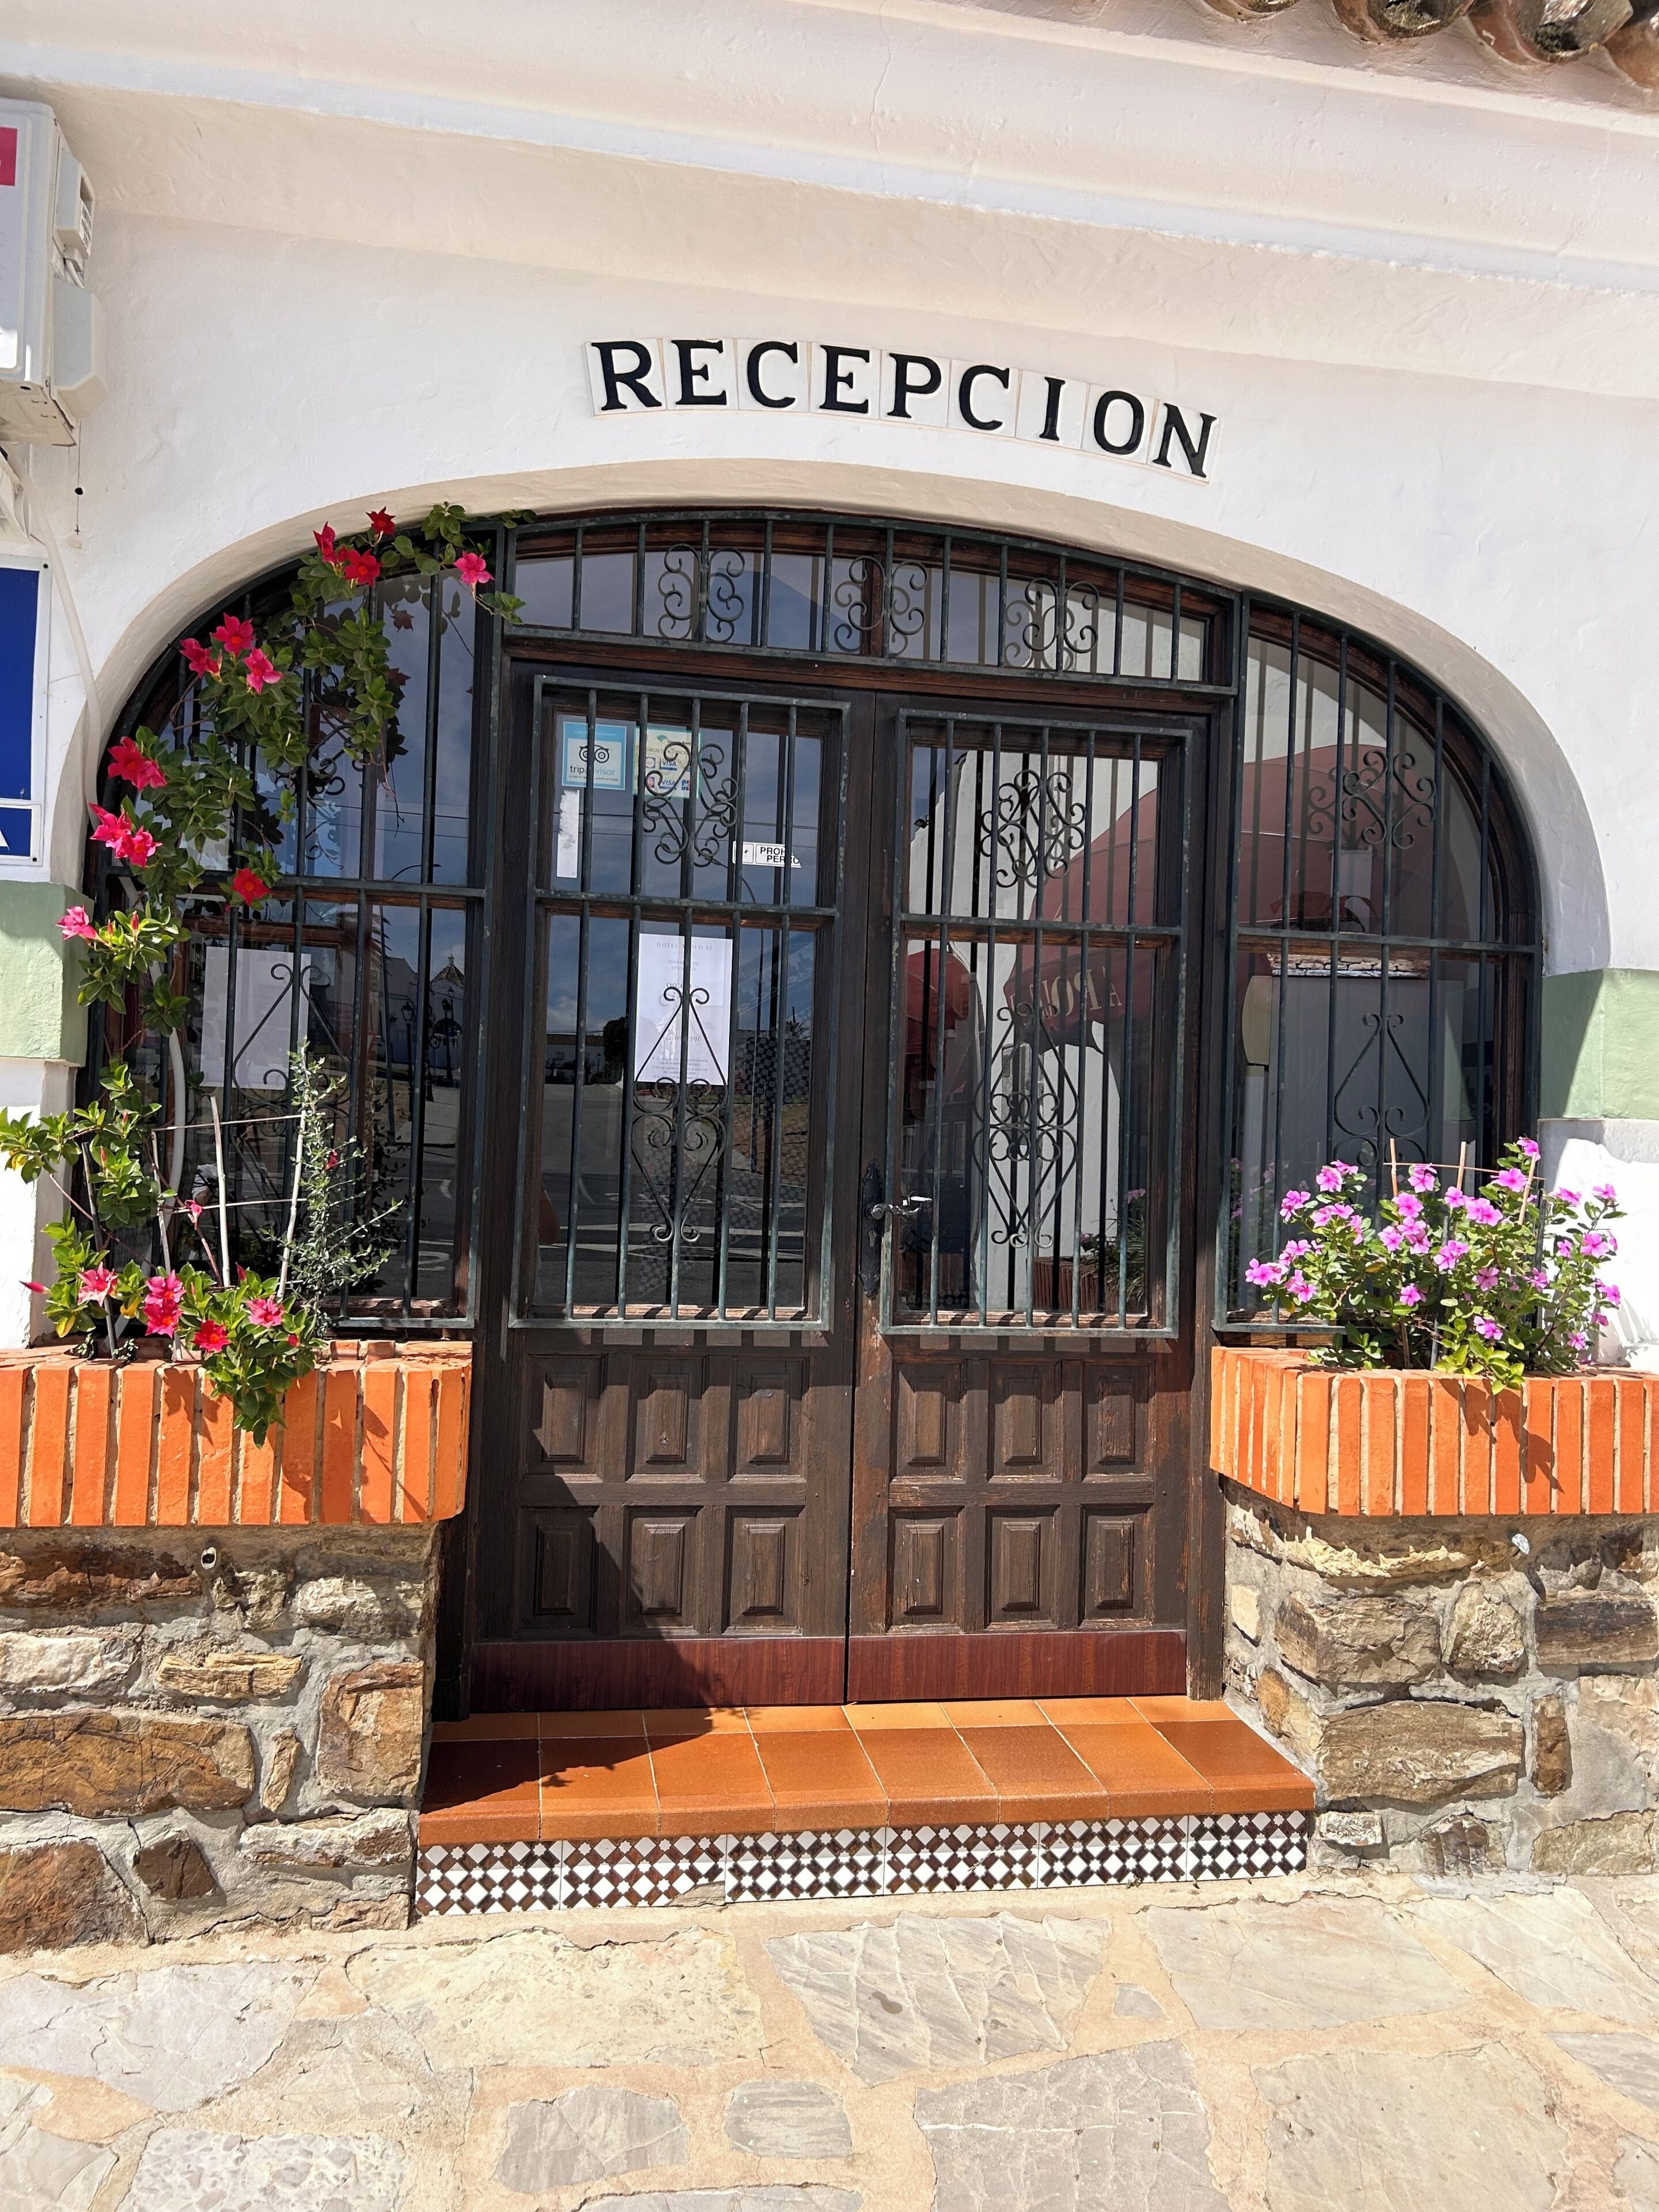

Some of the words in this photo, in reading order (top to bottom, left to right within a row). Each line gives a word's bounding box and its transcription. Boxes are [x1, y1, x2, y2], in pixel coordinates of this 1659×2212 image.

[591, 339, 1217, 478] RECEPCION
[570, 765, 615, 776] tripvisor
[767, 855, 799, 864] PERO
